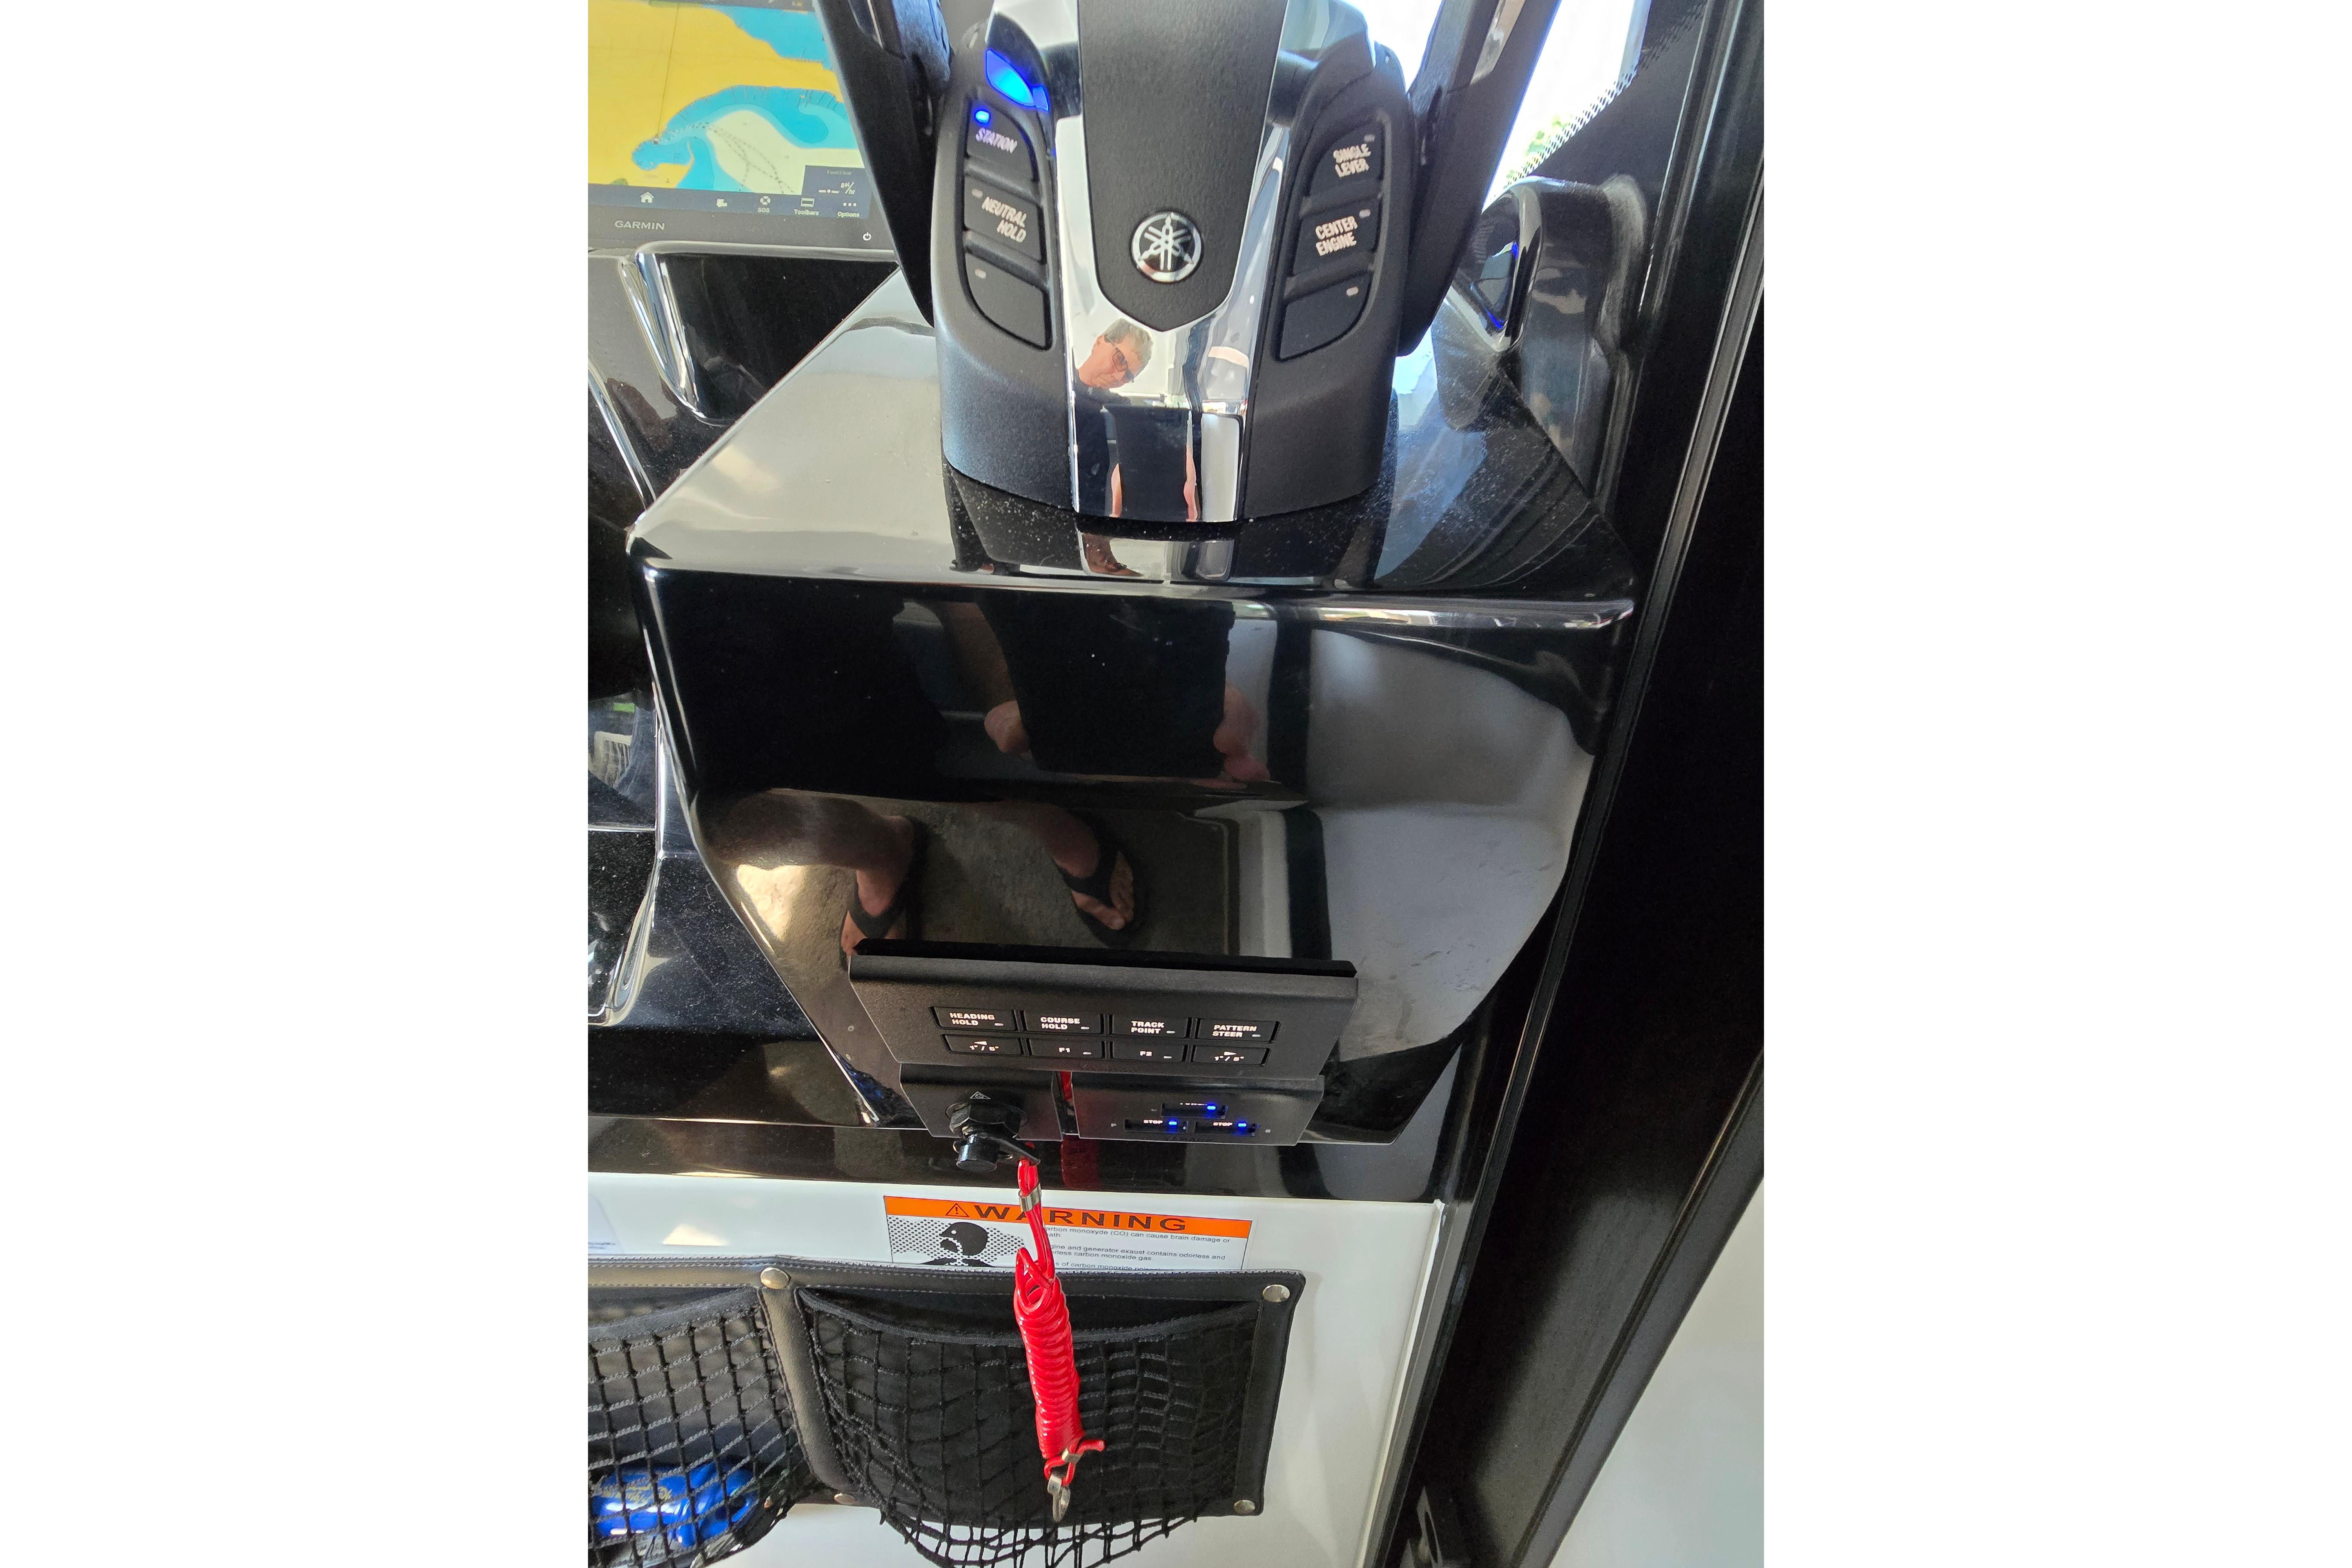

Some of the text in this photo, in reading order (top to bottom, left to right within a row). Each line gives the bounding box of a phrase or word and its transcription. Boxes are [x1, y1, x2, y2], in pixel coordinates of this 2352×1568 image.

[975, 128, 1018, 153] STATION
[1333, 143, 1371, 163] SINGLE
[1335, 158, 1369, 178] LEVER
[982, 196, 1027, 227] NEUTRAL
[614, 220, 665, 230] GARMIN
[997, 220, 1027, 242] HOLD
[1315, 216, 1358, 240] CENTER
[1316, 232, 1357, 256] ENGINE
[949, 1012, 995, 1020] HEADING
[973, 1205, 1186, 1231] WRNING
